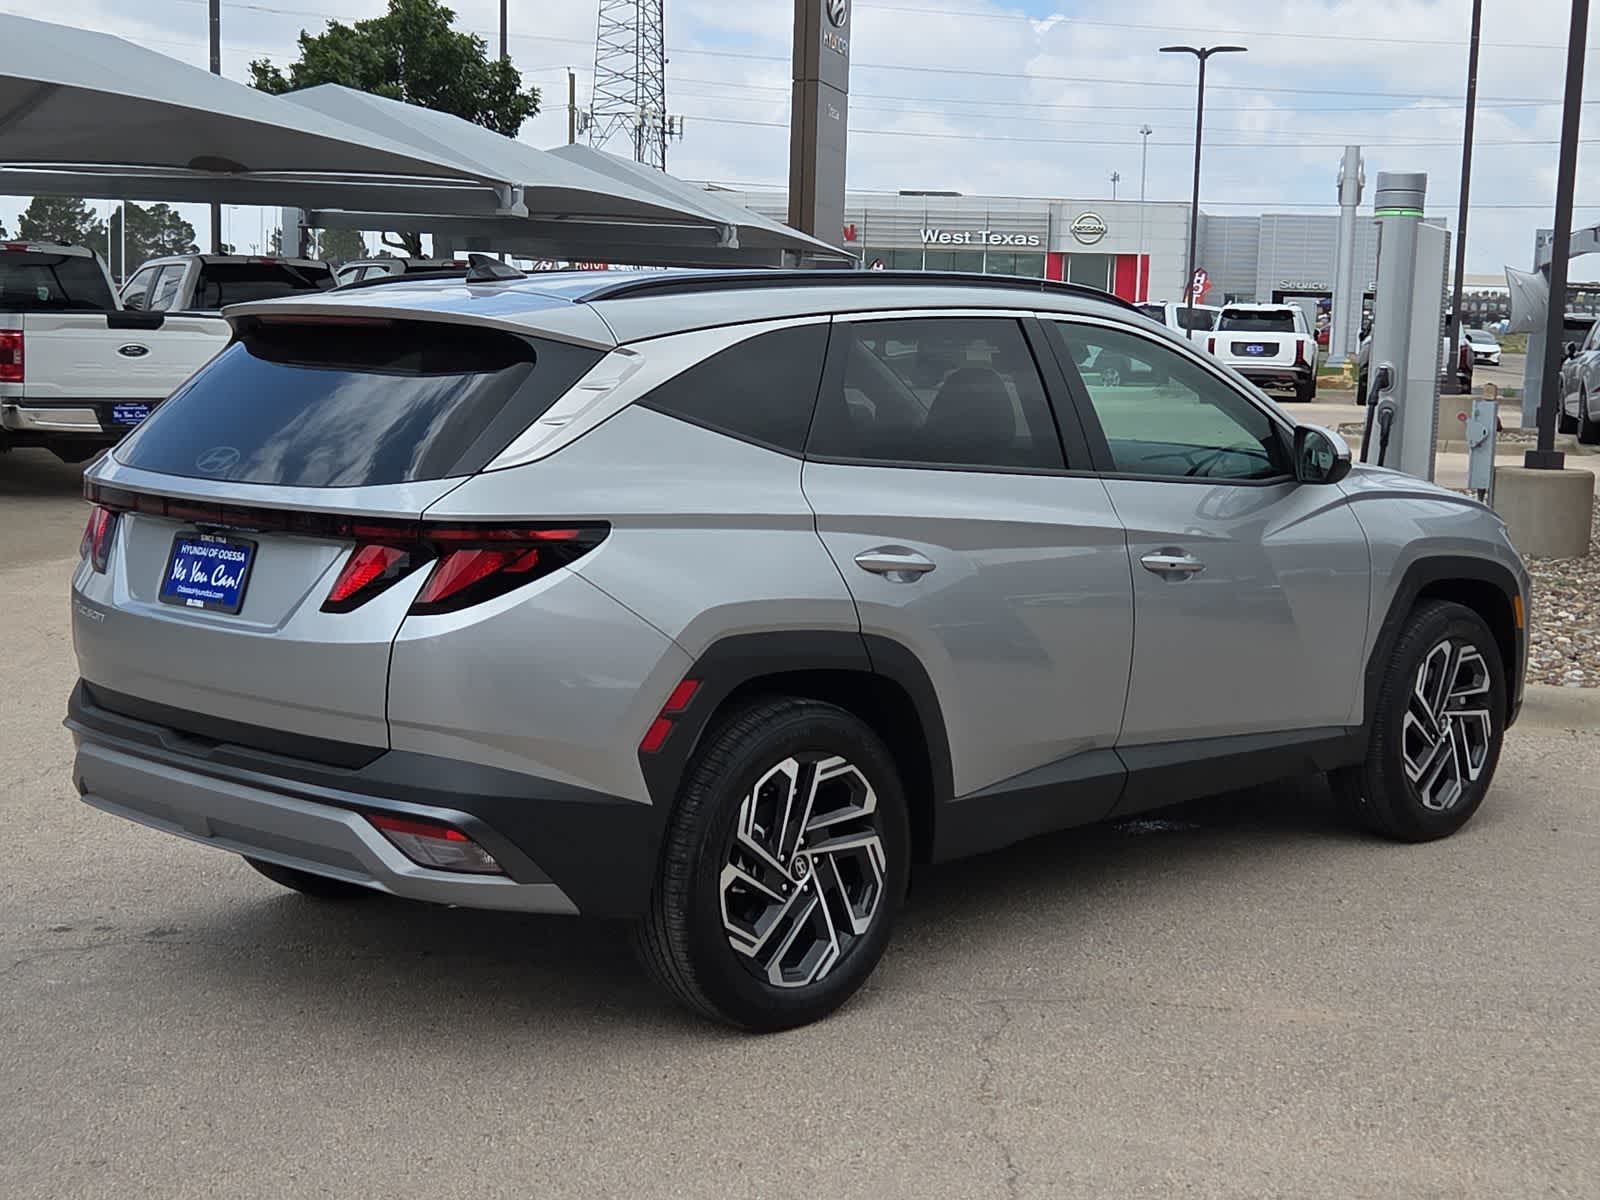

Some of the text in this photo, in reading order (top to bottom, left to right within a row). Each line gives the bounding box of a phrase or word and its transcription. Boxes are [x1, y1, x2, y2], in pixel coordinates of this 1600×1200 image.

[1073, 224, 1105, 233] NISSAN
[920, 229, 1040, 246] West Texas
[1279, 280, 1328, 290] Service
[181, 544, 245, 562] HYUNDAI OF ODESSA
[171, 558, 245, 590] Yes You Can!
